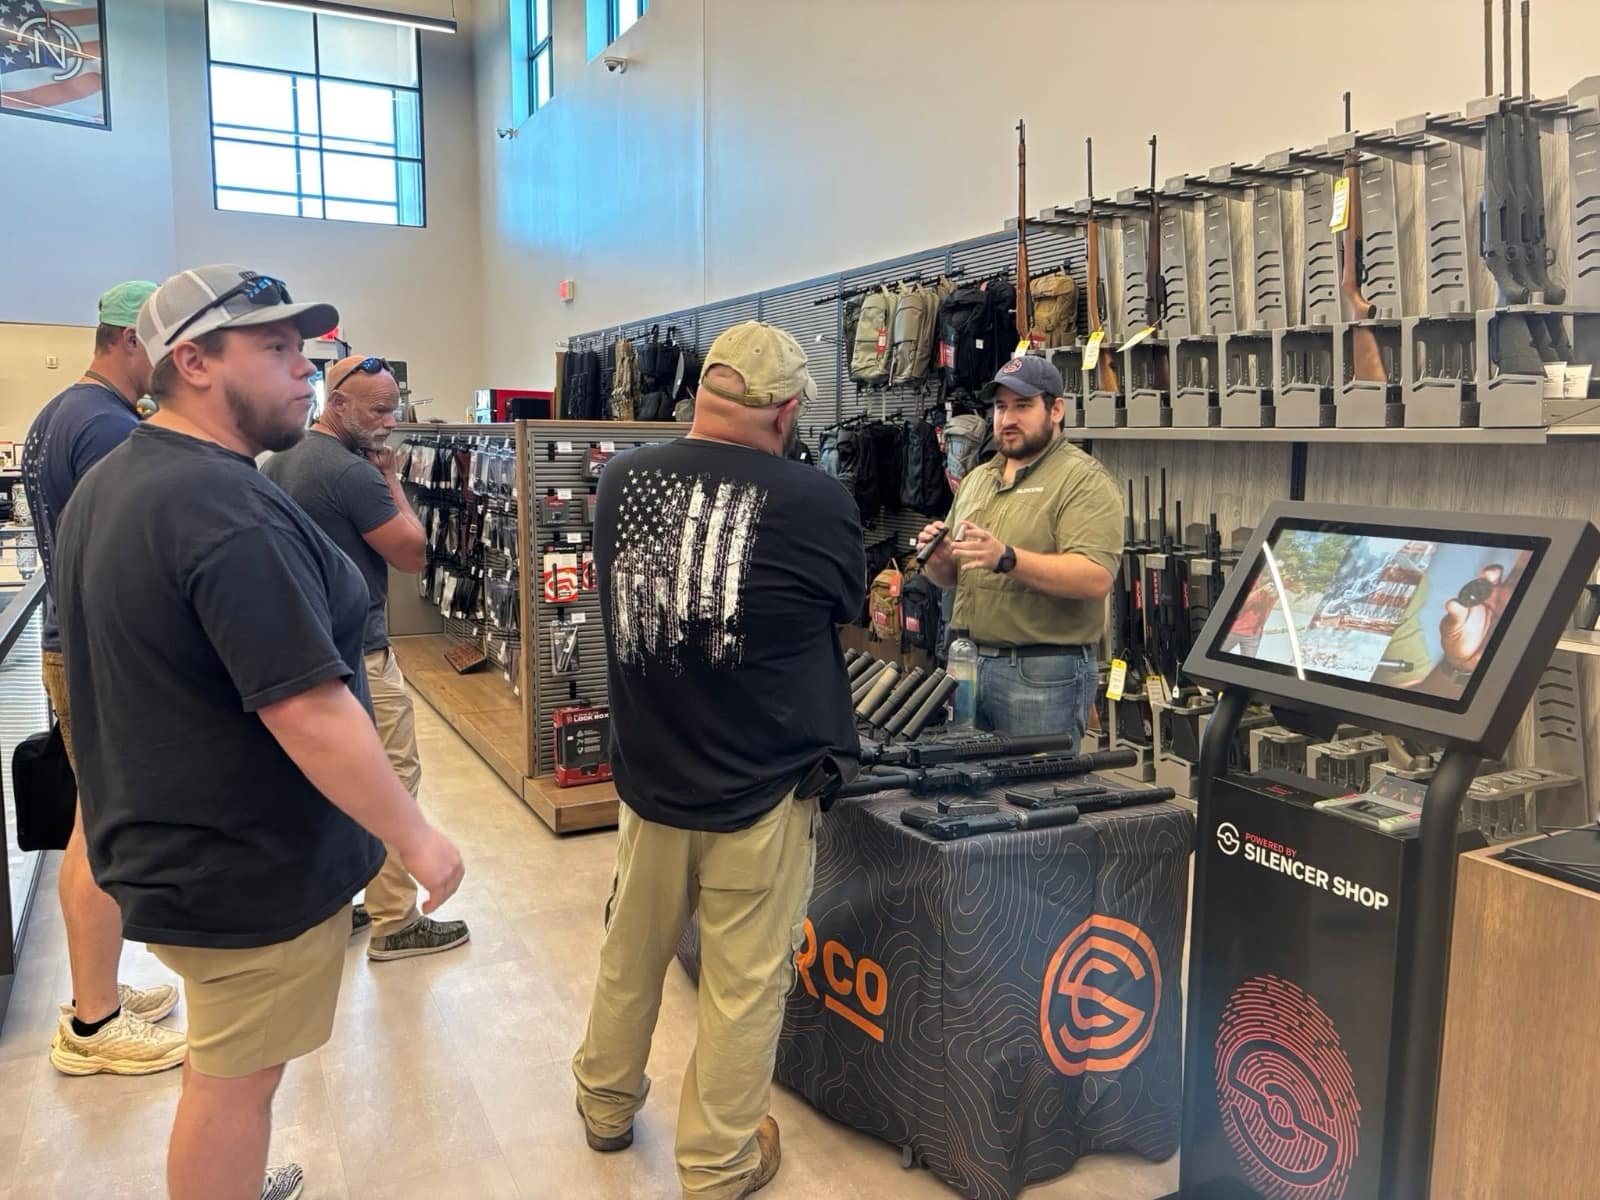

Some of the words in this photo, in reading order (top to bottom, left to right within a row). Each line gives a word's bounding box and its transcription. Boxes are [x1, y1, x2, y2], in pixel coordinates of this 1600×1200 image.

[1245, 832, 1284, 854] POWERED
[1285, 847, 1297, 858] BY
[1244, 842, 1329, 891] SILENCER
[1332, 875, 1389, 910] SHOP
